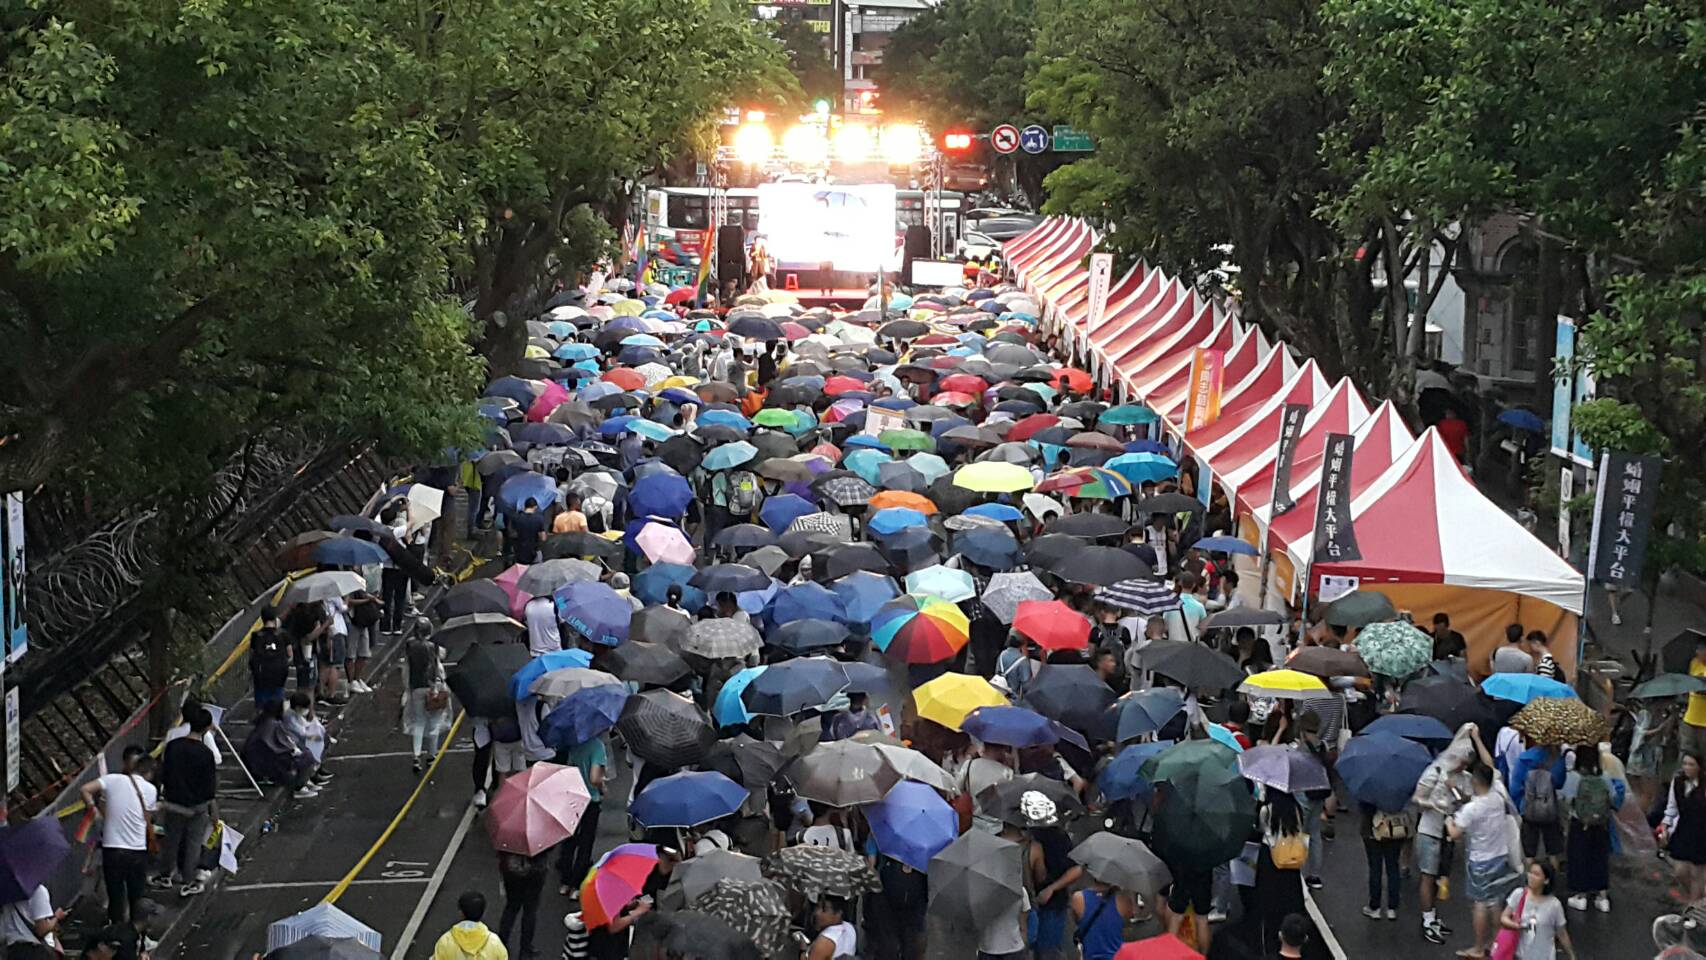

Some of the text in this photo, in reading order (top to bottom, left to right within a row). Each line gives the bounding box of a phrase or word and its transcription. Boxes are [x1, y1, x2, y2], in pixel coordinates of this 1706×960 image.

[1324, 440, 1345, 556] 婚姻平權大平台
[1608, 461, 1642, 579] 婚姻平權大平台
